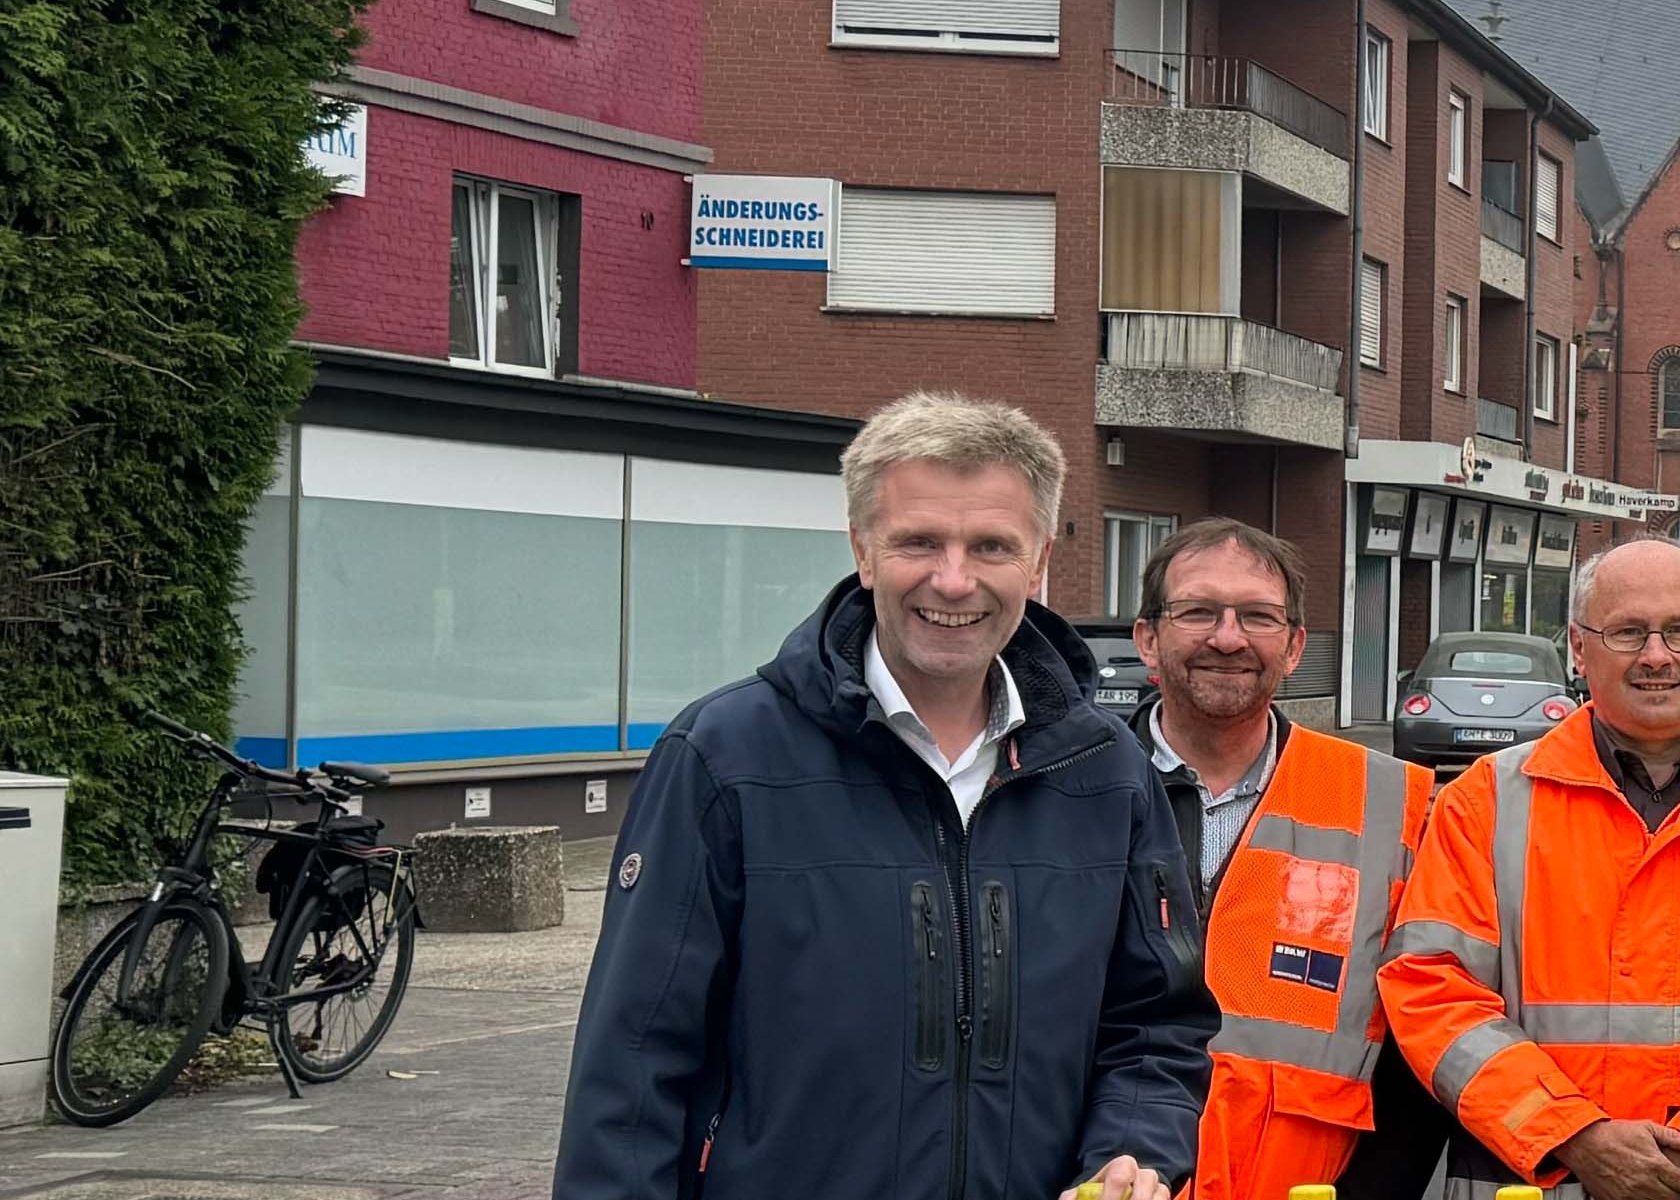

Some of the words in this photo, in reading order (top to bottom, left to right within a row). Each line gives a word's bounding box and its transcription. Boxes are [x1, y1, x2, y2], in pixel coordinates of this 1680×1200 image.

[698, 194, 824, 221] ÄNDERUNGS-
[695, 227, 824, 249] SCHNEIDEREI
[1618, 494, 1676, 509] Haverkamp
